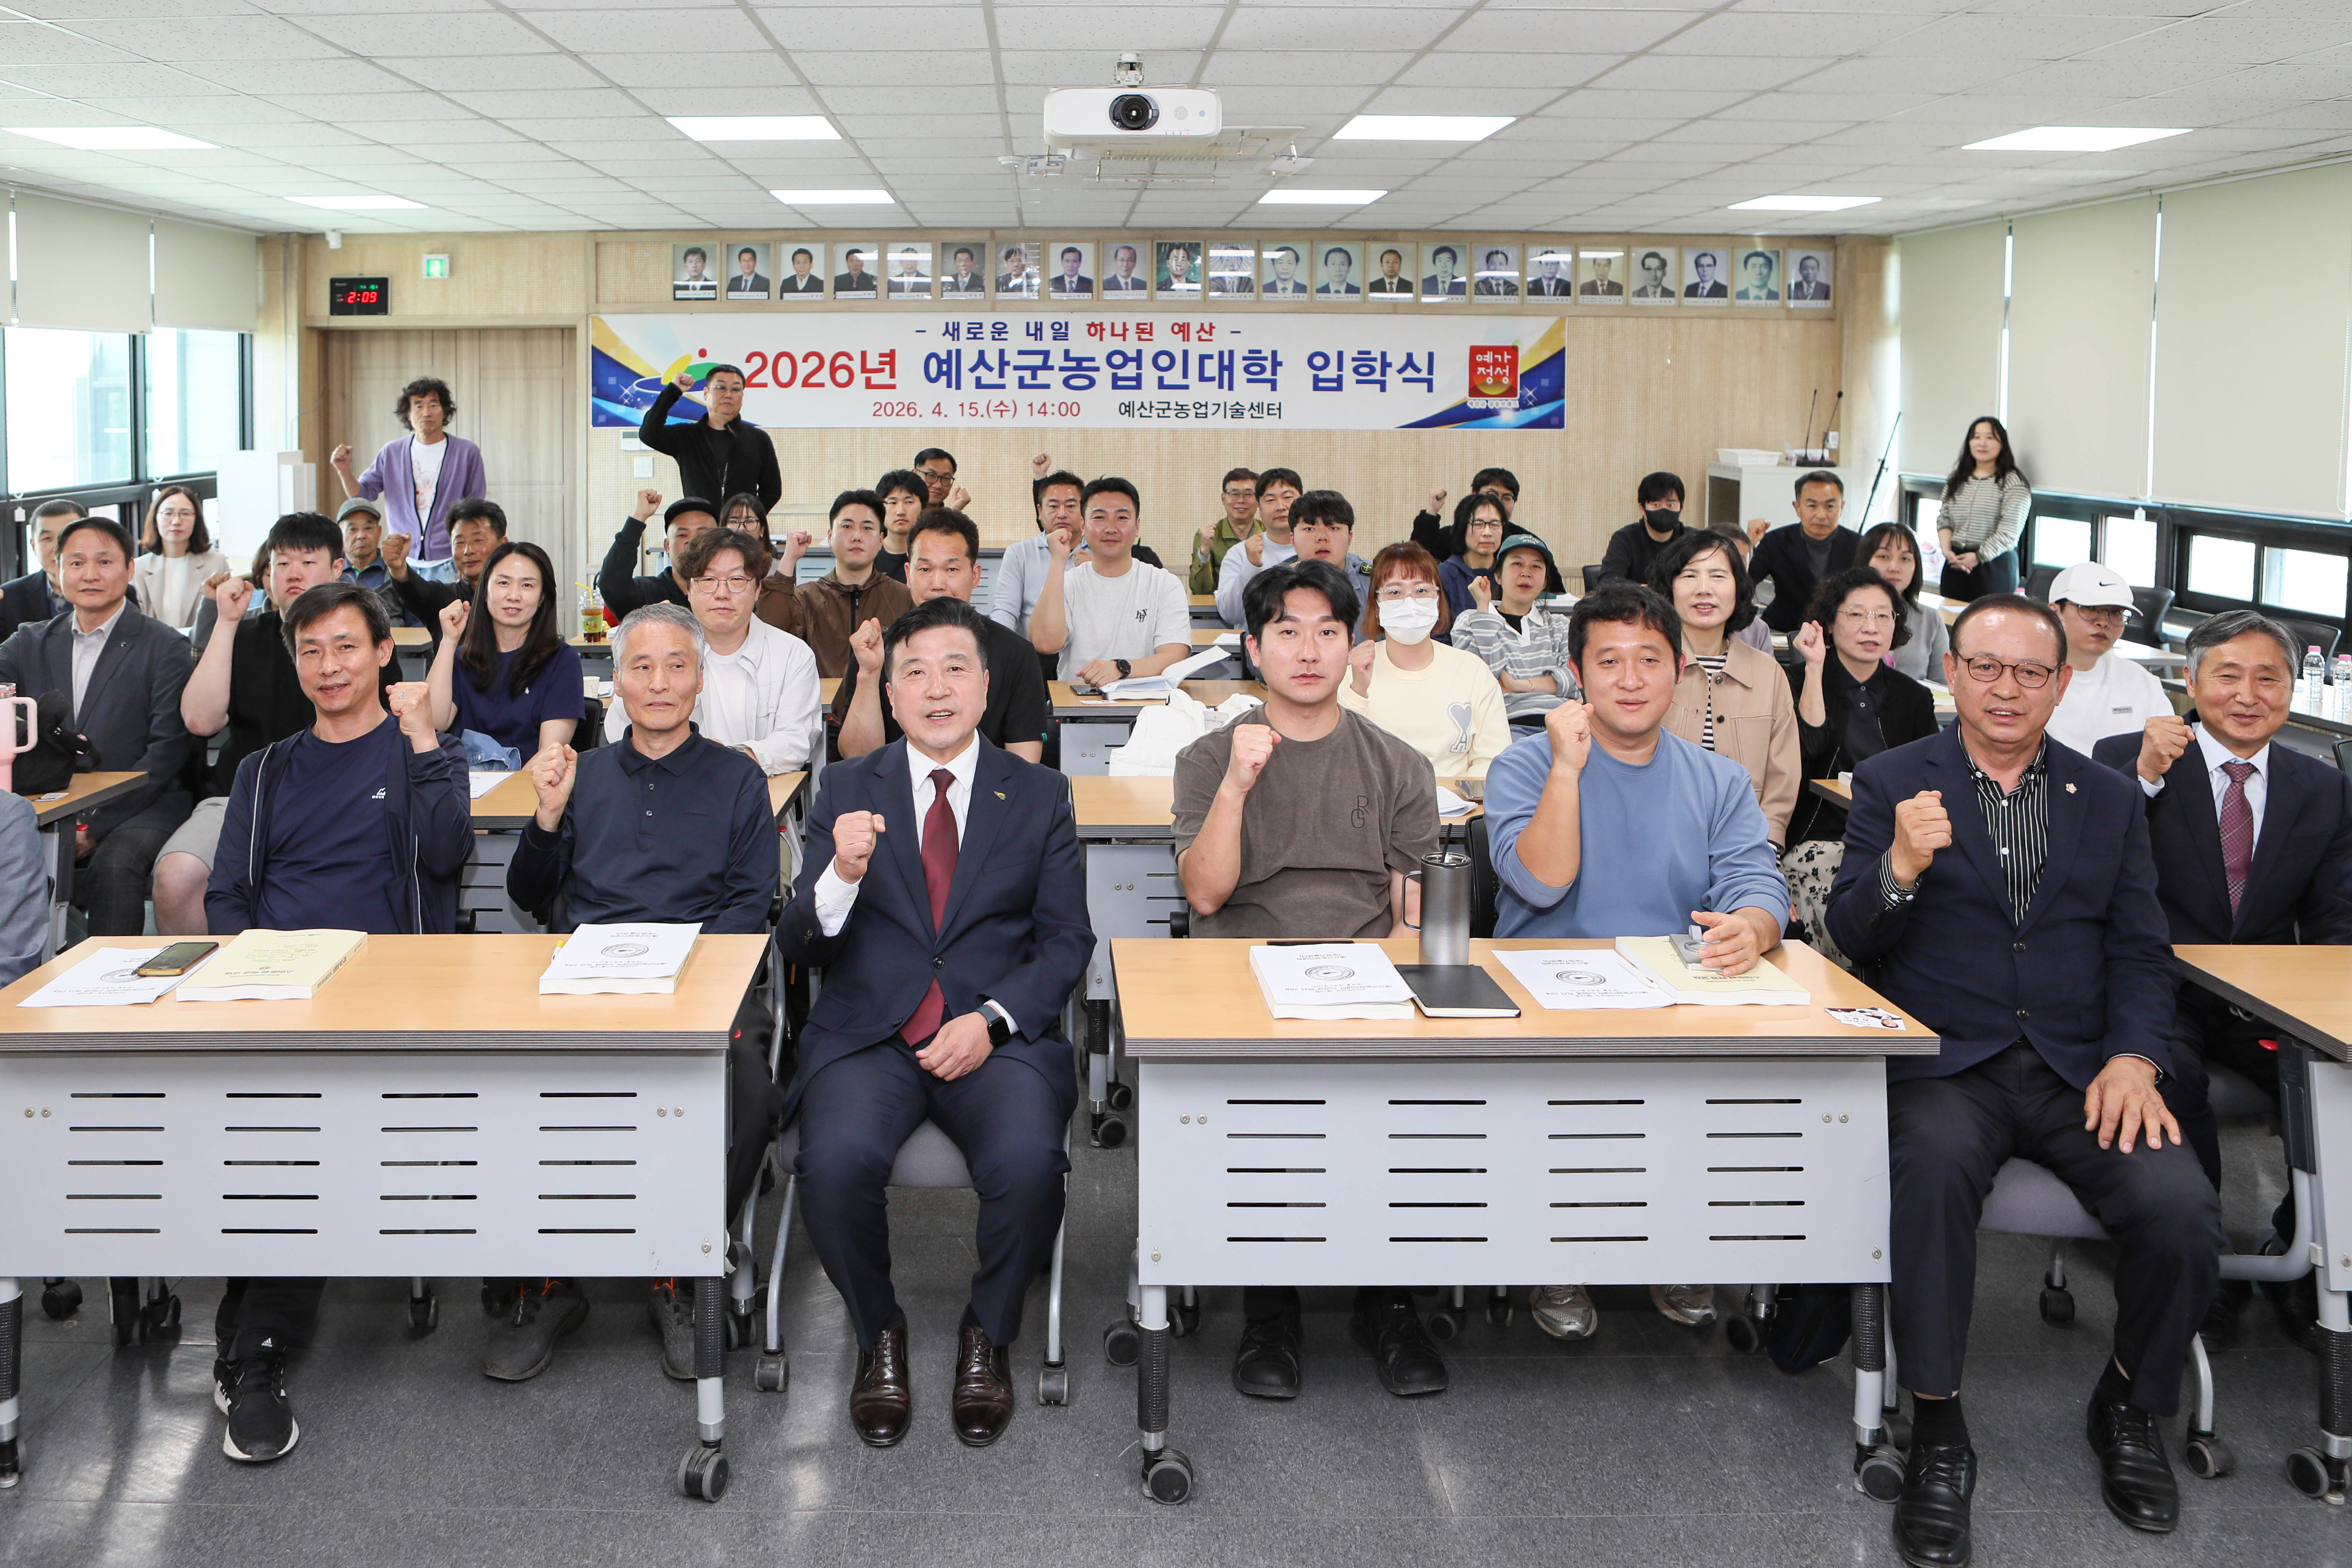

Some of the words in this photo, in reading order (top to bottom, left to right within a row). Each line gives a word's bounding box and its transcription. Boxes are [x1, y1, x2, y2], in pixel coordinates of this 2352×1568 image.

[347, 291, 378, 304] 2:09
[942, 321, 1010, 341] 새로운
[1026, 321, 1070, 341] 내일
[1087, 322, 1154, 342] 하나된
[1171, 322, 1216, 343] 예산
[1476, 351, 1512, 363] 예가
[745, 349, 897, 390] 2026년
[924, 349, 1284, 393] 예산군농업인대학
[1308, 349, 1435, 393] 입학식
[1477, 365, 1510, 384] 정성
[873, 402, 923, 417] 2026.
[932, 402, 948, 418] 4.
[960, 401, 1018, 420] 15.(수)
[1028, 402, 1081, 417] 14:00
[1118, 401, 1282, 420] 예산군농업기술센터
